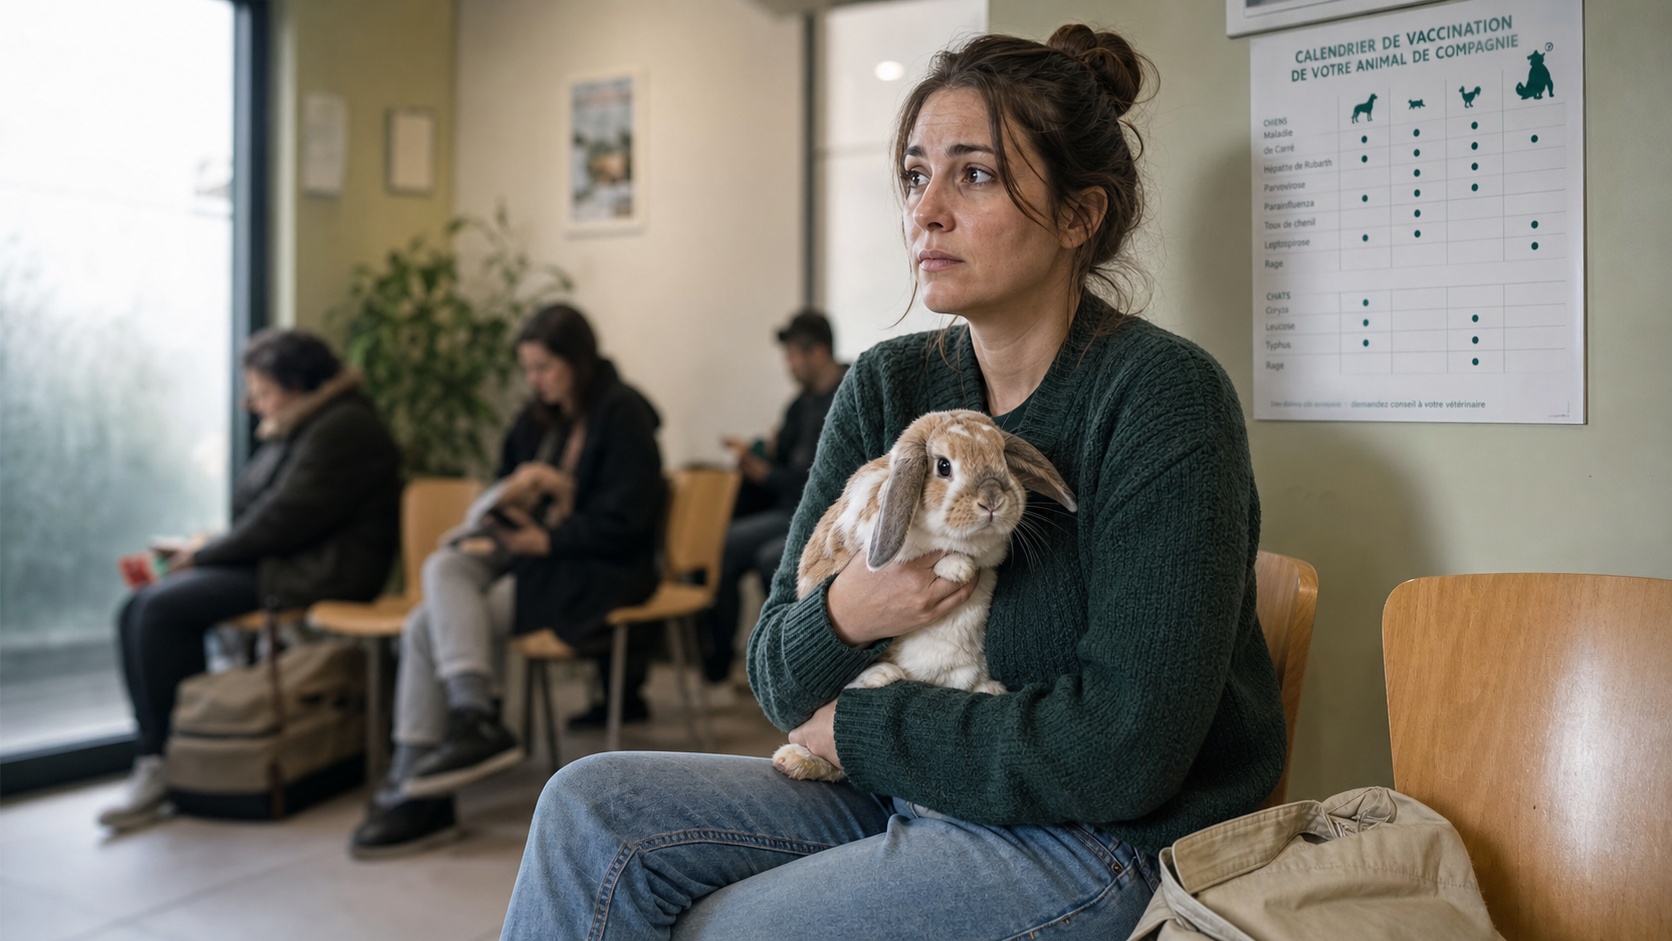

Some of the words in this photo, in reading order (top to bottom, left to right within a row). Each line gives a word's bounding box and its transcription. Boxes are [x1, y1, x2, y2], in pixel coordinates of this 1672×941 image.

[1295, 40, 1376, 64] CALENDRIER
[1382, 34, 1401, 49] DE
[1407, 15, 1513, 45] VACCINATION
[1291, 68, 1307, 82] DE
[1311, 64, 1352, 79] VOTRE
[1356, 53, 1407, 72] ANIMAL
[1412, 49, 1430, 63] DE
[1436, 34, 1519, 60] COMPAGNIE
[1263, 117, 1288, 127] CHIENS
[1263, 129, 1293, 139] Maladie
[1263, 147, 1273, 155] de
[1294, 162, 1303, 170] de
[1264, 182, 1306, 192] Parvovirose
[1264, 200, 1314, 211] Parainfluenza
[1265, 221, 1281, 230] Toux
[1283, 220, 1292, 229] de
[1294, 217, 1316, 228] chenil
[1264, 239, 1310, 250] Leptospirose
[1265, 260, 1284, 270] Rage
[1266, 291, 1291, 301] CHATS
[1265, 340, 1292, 351] Typhus
[1265, 361, 1284, 371] Rage
[1351, 400, 1389, 409] demandez
[1390, 400, 1417, 409] conseil
[1424, 401, 1443, 409] votre
[1445, 399, 1486, 409] vétérinaire
